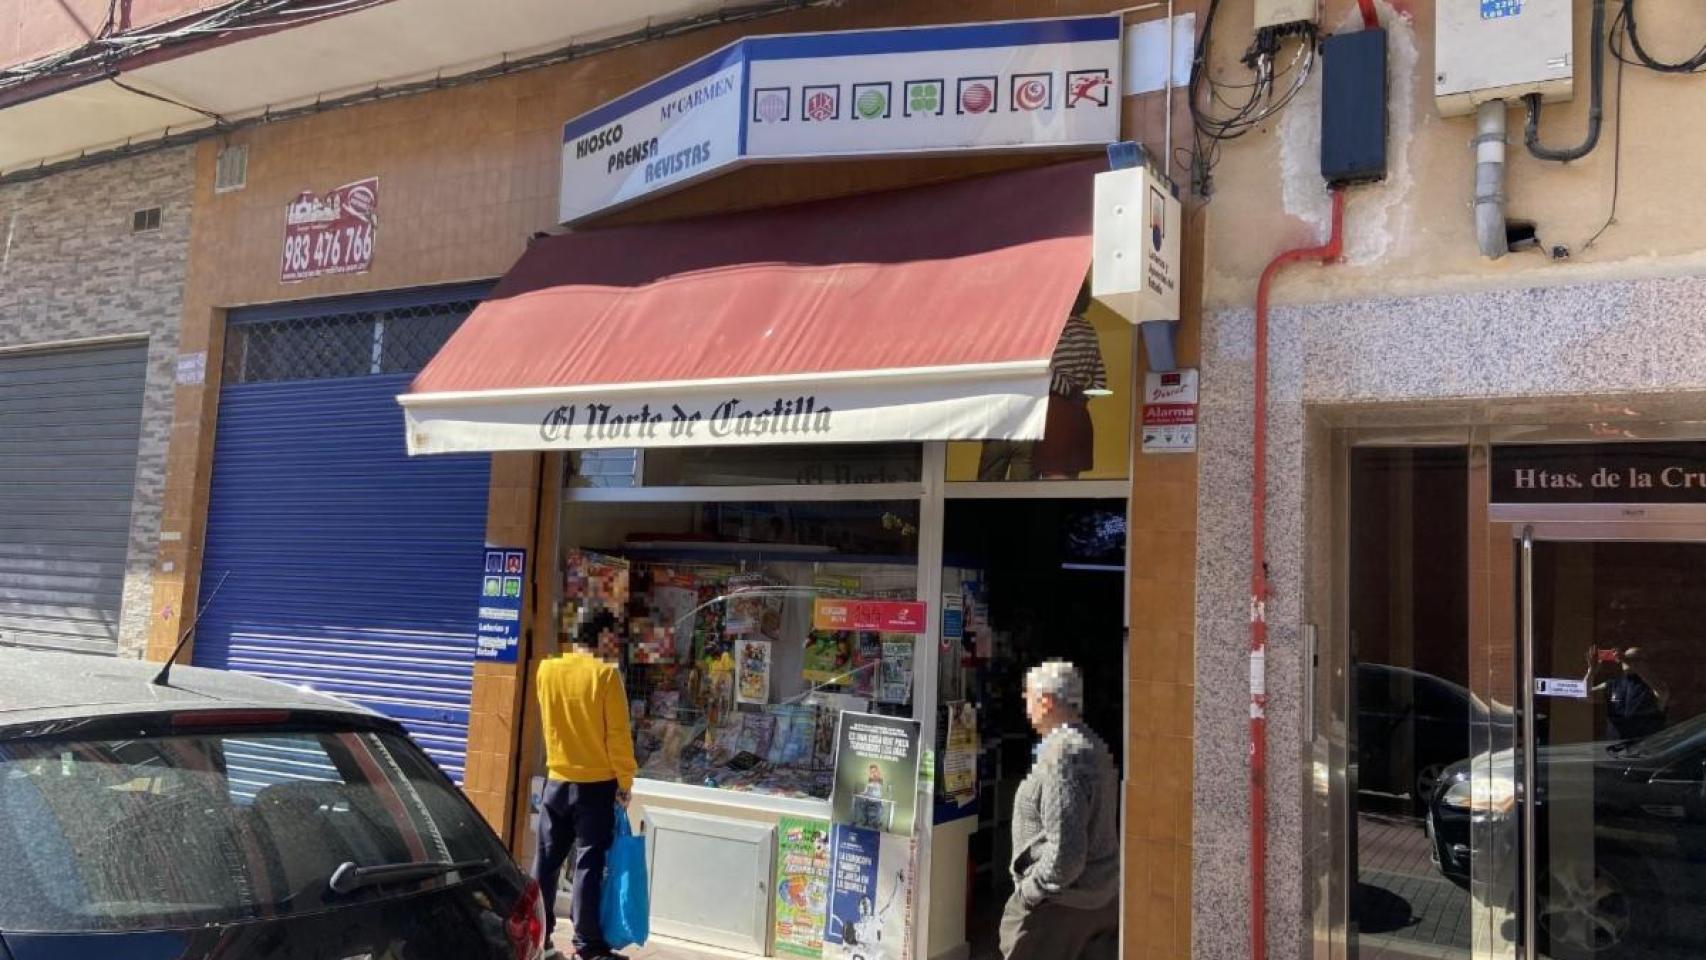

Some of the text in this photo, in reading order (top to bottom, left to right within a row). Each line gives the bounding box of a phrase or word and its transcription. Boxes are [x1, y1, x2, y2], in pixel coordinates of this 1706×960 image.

[677, 74, 734, 114] CARMEN
[576, 124, 623, 159] KIOSCO
[607, 137, 659, 173] PRENSA
[645, 140, 711, 183] REVISTAS
[285, 234, 310, 271] 983
[314, 229, 340, 267] 476
[345, 223, 371, 263] 766
[540, 396, 832, 442] El Norte de Castilla
[1146, 407, 1194, 418] Alarma
[1513, 468, 1583, 488] Htas.
[1590, 467, 1621, 488] de
[1629, 467, 1652, 488] la
